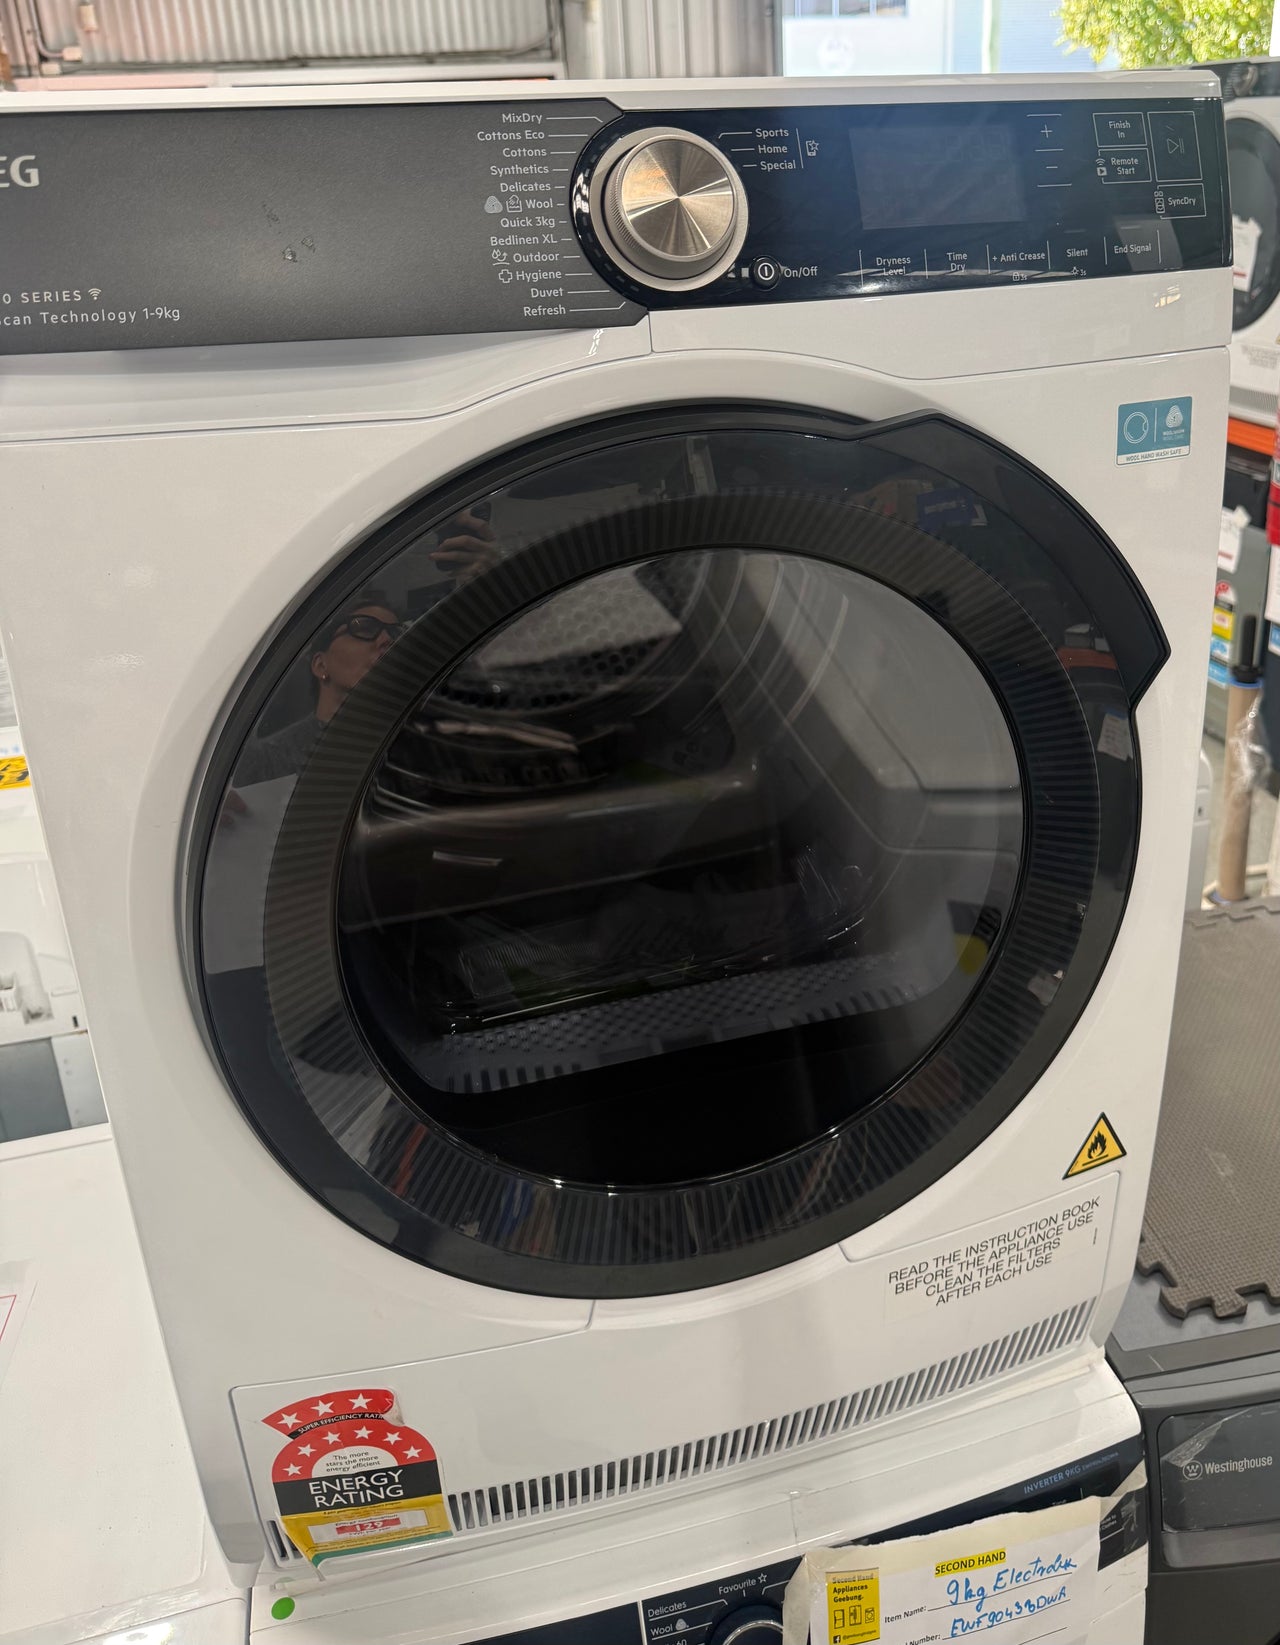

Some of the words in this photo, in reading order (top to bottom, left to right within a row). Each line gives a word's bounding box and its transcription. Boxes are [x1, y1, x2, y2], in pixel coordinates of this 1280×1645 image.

[501, 113, 543, 124] MixDry
[1108, 120, 1131, 129] Finish
[477, 131, 522, 141] Cottons
[524, 130, 545, 140] Eco
[755, 128, 790, 139] Sports
[1117, 130, 1125, 138] In
[502, 148, 547, 157] Cottons
[758, 144, 788, 153] Home
[760, 160, 796, 172] Special
[1111, 157, 1139, 166] Remote
[490, 164, 549, 177] Synthetics
[1117, 167, 1135, 175] Start
[500, 182, 551, 193] Delicates
[525, 198, 554, 209] Wool
[1167, 196, 1197, 206] SyncDry
[500, 217, 533, 228] Quick
[535, 216, 556, 228] 3kg
[490, 235, 539, 246] Bedlinen
[542, 234, 558, 244] XL
[1066, 248, 1088, 257] Silent
[1114, 245, 1127, 254] End
[1129, 243, 1152, 253] Signal
[513, 252, 560, 263] Outdoor
[876, 256, 911, 267] Dryness
[947, 252, 968, 261] Time
[1000, 253, 1017, 263] Anti
[1019, 252, 1046, 261] Crease
[783, 266, 819, 278] On/Off
[883, 266, 906, 276] Level
[950, 263, 966, 272] Dry
[516, 270, 562, 282] Hygiene
[21, 290, 82, 303] SERIES
[530, 287, 564, 298] Duvet
[0, 315, 31, 326] can
[40, 309, 137, 324] Technology
[143, 306, 180, 321] 1-9kg
[523, 304, 567, 317] Refresh
[888, 1261, 928, 1284] READ
[933, 1250, 961, 1268] THE
[965, 1213, 1059, 1257] INSTRUCTION
[1062, 1195, 1100, 1221] BOOK
[895, 1266, 953, 1294] BEFORE
[958, 1254, 984, 1272] THE
[988, 1224, 1064, 1262] APPLIANCE
[1068, 1211, 1094, 1232] USE
[926, 1274, 972, 1297] CLEAN
[977, 1262, 1004, 1279] THE
[1008, 1237, 1060, 1266] FILTERS
[935, 1281, 980, 1306] AFTER
[985, 1266, 1022, 1288] EACH
[1026, 1252, 1053, 1272] USE
[320, 1413, 363, 1425] EFFICIENCY
[352, 1461, 380, 1469] efficient
[1205, 1456, 1273, 1474] Westinghouse
[309, 1469, 403, 1495] ENERGY
[1023, 1472, 1064, 1494] INVERTER
[1065, 1465, 1081, 1478] 9KG
[314, 1484, 404, 1508] RATING
[935, 1557, 975, 1575] SECOND
[977, 1550, 1007, 1566] HAND
[718, 1578, 757, 1595] Favourite
[833, 1584, 868, 1596] Appliances
[648, 1602, 687, 1618] Delicates
[884, 1613, 902, 1624] Item
[903, 1605, 927, 1618] Name:
[650, 1624, 673, 1636] Wool
